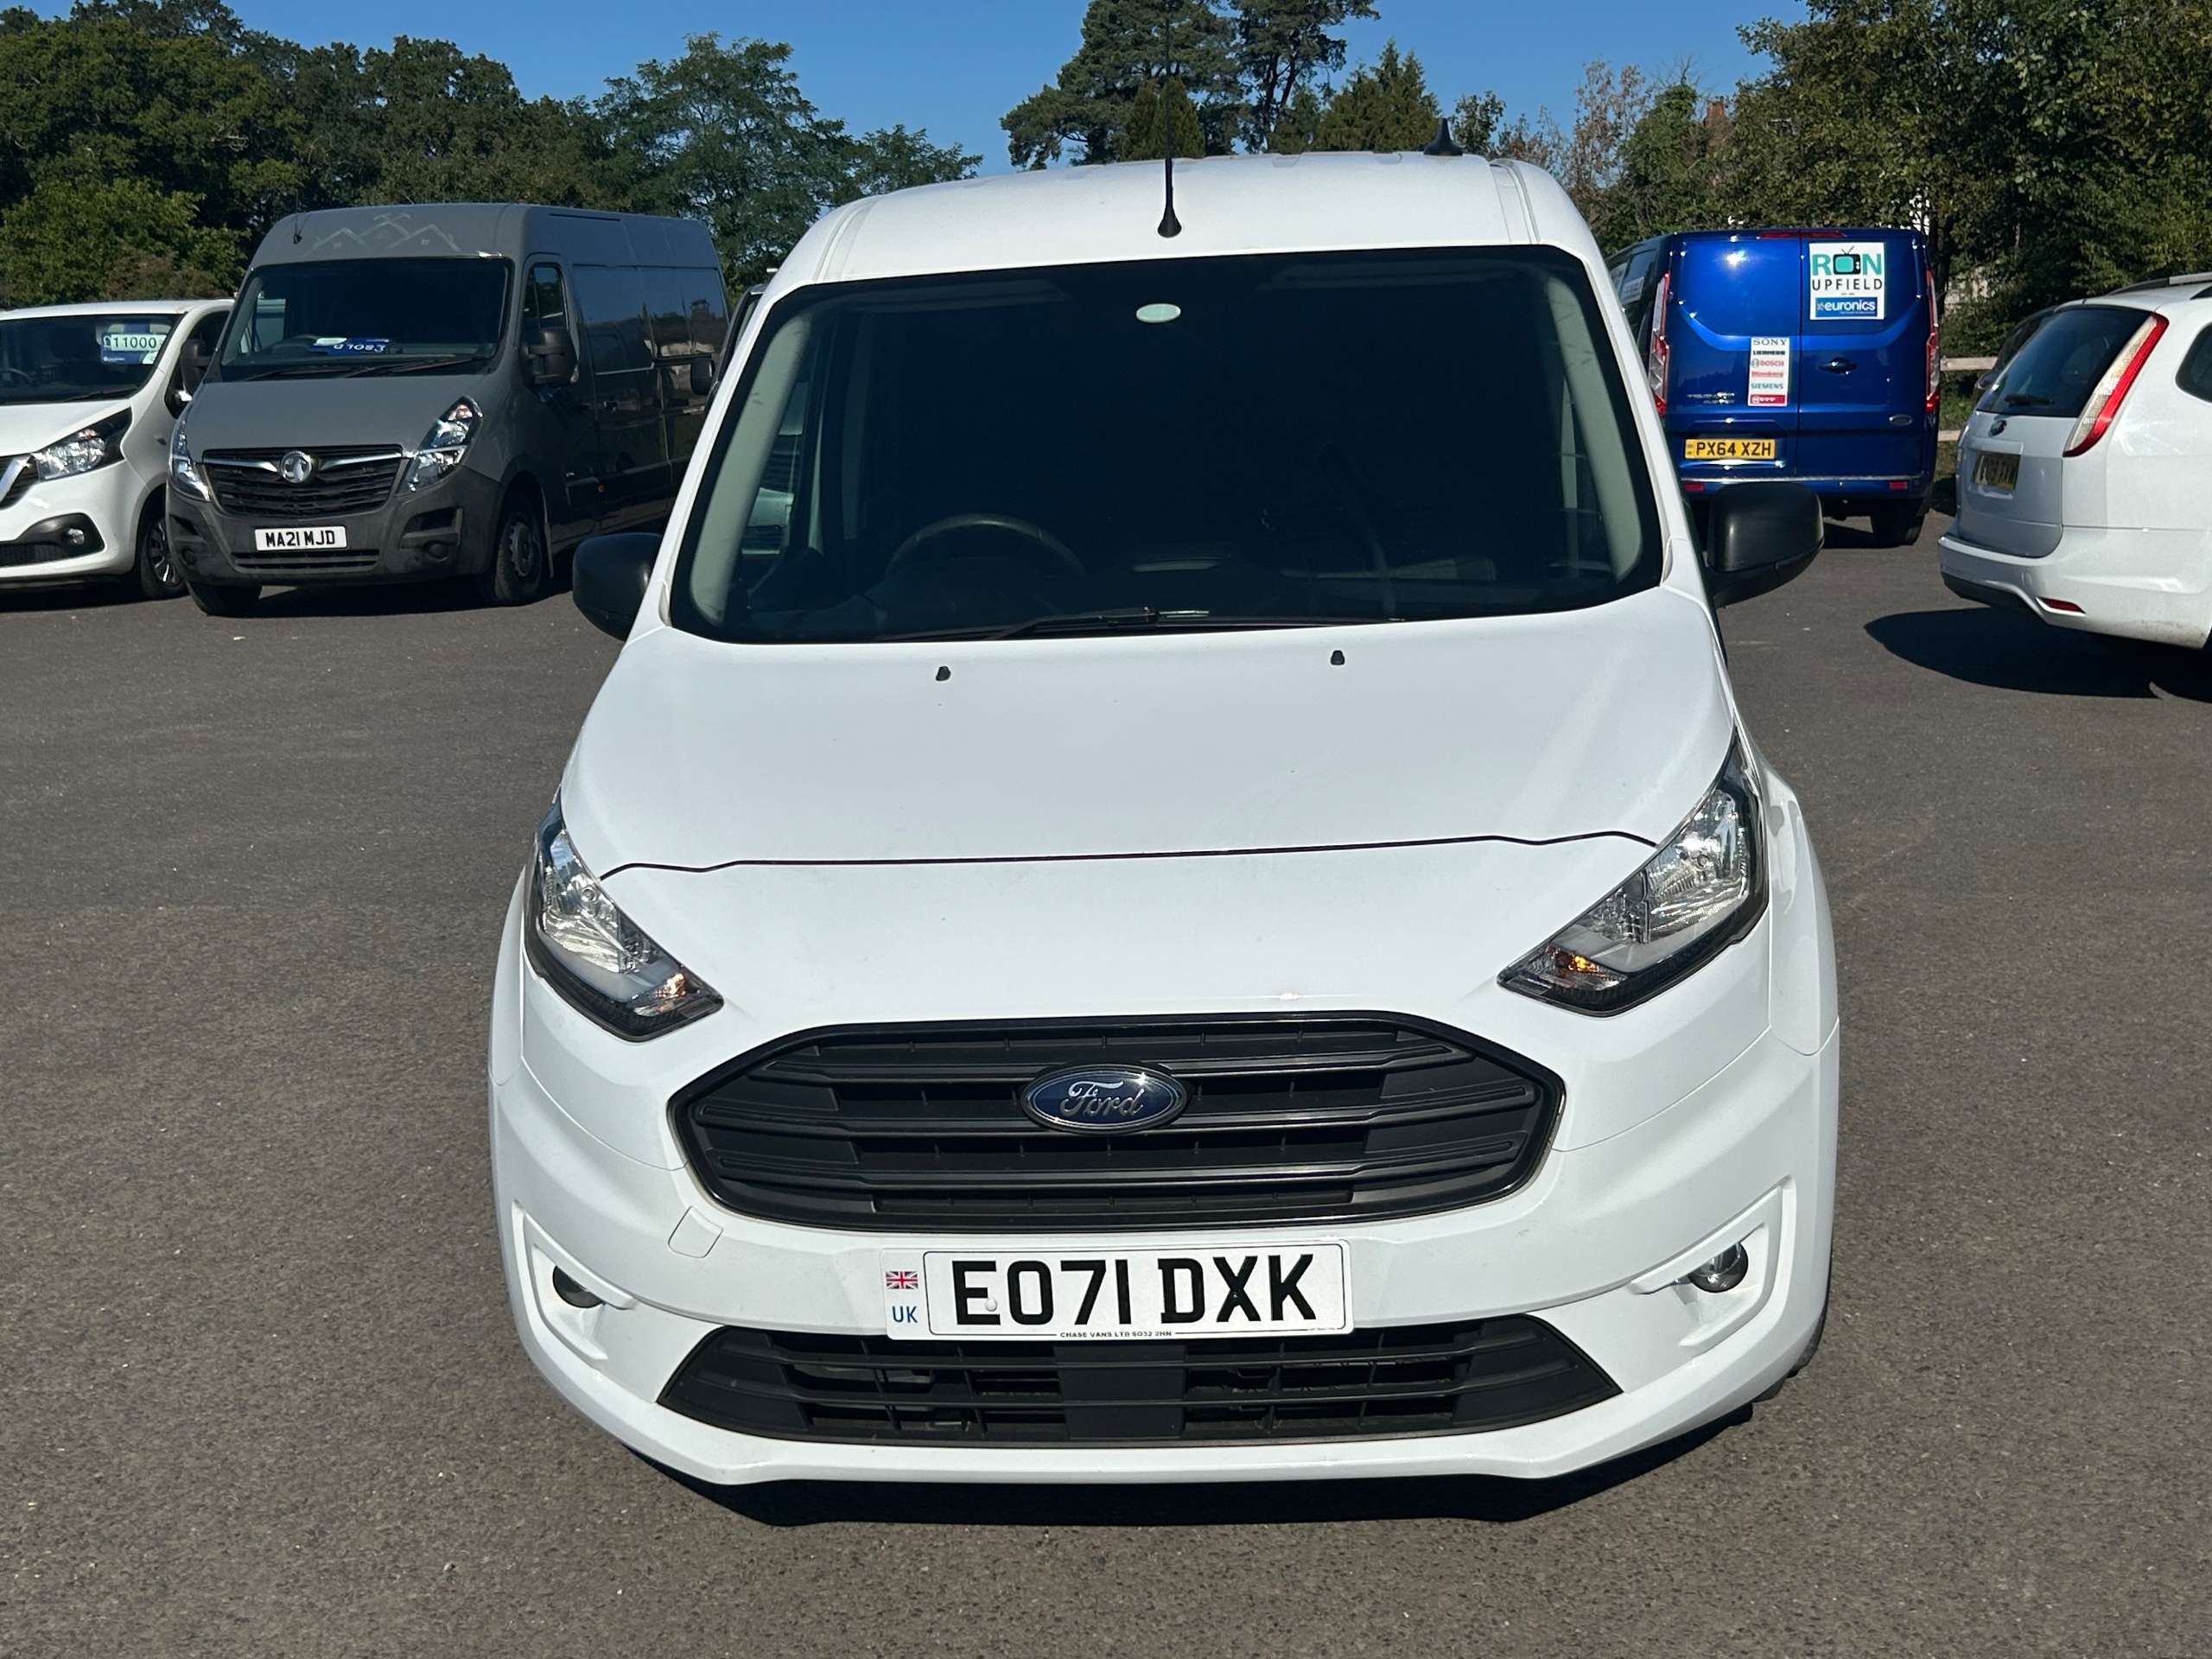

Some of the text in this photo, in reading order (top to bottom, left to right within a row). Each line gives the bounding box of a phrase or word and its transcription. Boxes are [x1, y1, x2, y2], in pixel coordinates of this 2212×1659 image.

[1812, 278, 1883, 290] UPFIELD
[1824, 300, 1876, 311] euronics
[1696, 442, 1771, 456] PX64 XZH
[265, 530, 335, 548] MA21 MJD
[1059, 1081, 1145, 1117] Ford
[1157, 1253, 1317, 1325] DXK
[892, 1306, 918, 1324] UK
